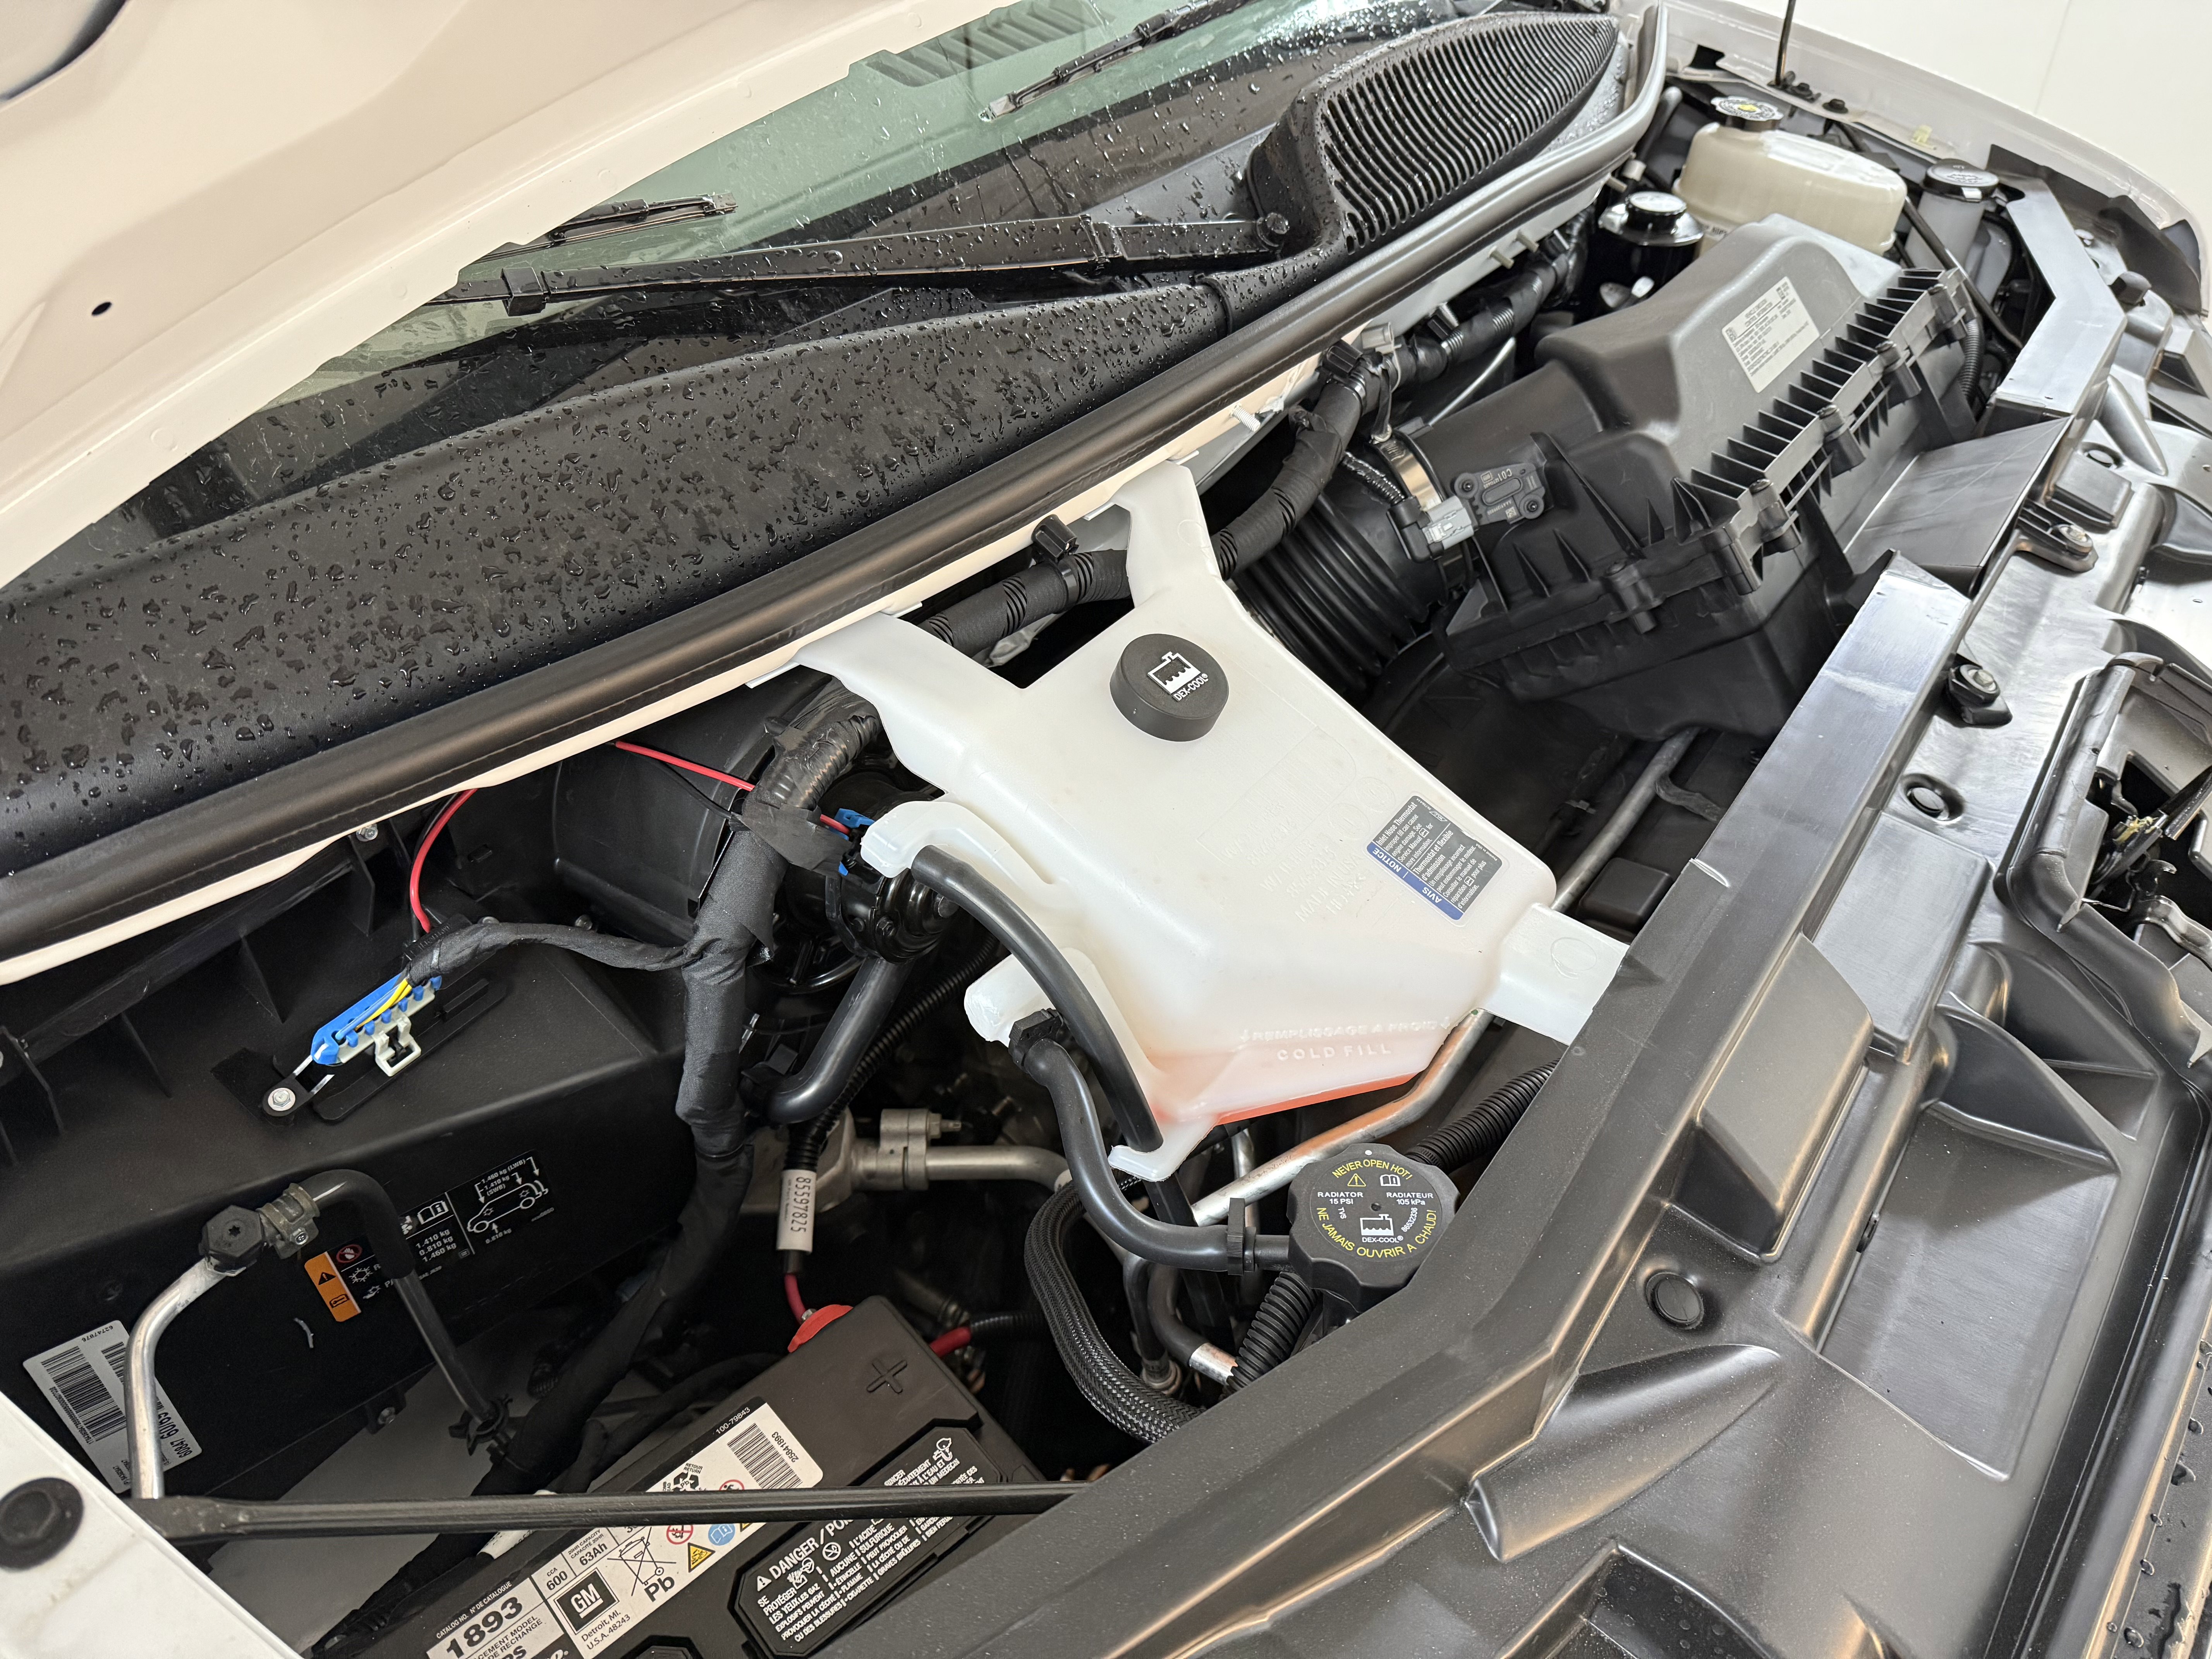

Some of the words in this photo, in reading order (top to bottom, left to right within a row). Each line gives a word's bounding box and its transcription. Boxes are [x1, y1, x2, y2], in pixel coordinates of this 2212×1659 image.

[1376, 833, 1388, 846] Inlet
[1384, 823, 1398, 836] Hose
[1393, 801, 1417, 826] Thermostat
[1384, 834, 1401, 852] Improper
[1401, 824, 1410, 832] can
[1407, 814, 1419, 825] cause
[1391, 843, 1405, 857] engine
[1400, 829, 1417, 846] damage.
[1412, 822, 1422, 832] See
[1397, 847, 1412, 862] Service
[1408, 835, 1423, 850] Manual
[1425, 822, 1434, 830] for
[1432, 844, 1441, 852] et
[1436, 829, 1454, 847] flexible
[1372, 847, 1402, 872] NOTICE
[1405, 857, 1416, 868] more
[1412, 836, 1433, 859] information.
[1412, 849, 1437, 875] Thermostat
[1449, 843, 1466, 861] incorrect
[1420, 853, 1446, 881] d'admission
[1432, 859, 1455, 882] remplissage
[1435, 882, 1446, 893] peut
[1441, 860, 1464, 884] endommager
[1462, 844, 1477, 859] moteur.
[1428, 879, 1437, 887] Un
[1442, 879, 1460, 898] Consulter
[1458, 862, 1473, 878] manuel
[1449, 883, 1469, 904] réparation
[1470, 867, 1482, 879] pour
[1476, 859, 1488, 870] plus
[1421, 886, 1442, 904] AVIS
[1456, 883, 1480, 909] d'information.
[1278, 1046, 1335, 1061] COLD
[1344, 1044, 1392, 1057] FILL
[1332, 1161, 1363, 1178] NEVER
[1363, 1159, 1389, 1169] OPEN
[1390, 1164, 1413, 1180] HOT!
[790, 1176, 811, 1233] 85597825
[1317, 1207, 1329, 1221] NE
[1338, 1207, 1346, 1219] TVS
[1401, 1207, 1417, 1232] 86532336
[1415, 1209, 1436, 1243] CHAUD!
[414, 1233, 439, 1250] 1.410
[438, 1227, 451, 1238] kg
[442, 1235, 455, 1245] kg
[445, 1241, 458, 1252] kg
[1322, 1223, 1355, 1251] JAMAIS
[1357, 1246, 1405, 1258] OUVRIR
[715, 1406, 751, 1435] 100-79843
[169, 1435, 193, 1460] 60847
[771, 1430, 799, 1463] 25841893
[683, 1465, 701, 1475] RETURN
[685, 1461, 702, 1471] RETOUR
[921, 1464, 939, 1480] L'EAU
[936, 1459, 946, 1469] ET
[966, 1465, 978, 1477] DES
[679, 1479, 690, 1489] Pb
[928, 1475, 939, 1485] UN
[579, 1528, 601, 1547] CAPACITY
[852, 1523, 878, 1546] L'ACIDE
[858, 1522, 895, 1554] SULFURIQUE
[865, 1547, 881, 1561] PEUT
[878, 1525, 908, 1551] PROVOQUER
[924, 1525, 938, 1537] BIEN
[570, 1541, 593, 1559] CAPACITÉ
[578, 1540, 608, 1567] 63Ah
[768, 1535, 820, 1580] DANGER
[871, 1559, 881, 1569] LA
[877, 1546, 896, 1563] CÉCITÉ
[893, 1540, 904, 1551] OU
[901, 1535, 911, 1544] DE
[546, 1566, 558, 1577] CCA
[828, 1551, 858, 1577] AUCUNE
[834, 1561, 862, 1585] ÉTINCELLE
[876, 1557, 899, 1576] GRAVES
[544, 1570, 569, 1592] 600
[643, 1571, 677, 1602] Pb
[797, 1591, 809, 1603] LES
[807, 1582, 821, 1595] GAZ
[840, 1572, 864, 1593] FLAMME
[846, 1576, 875, 1601] CIGARETTE
[435, 1618, 460, 1639] CATALOG
[458, 1612, 469, 1623] NO.
[475, 1601, 484, 1610] DE
[483, 1580, 513, 1605] CATALOGUE
[568, 1583, 601, 1614] GM
[757, 1595, 770, 1608] SE
[761, 1585, 798, 1616] PROTÉGER
[768, 1609, 784, 1625] LES
[780, 1596, 801, 1614] YEUX
[775, 1607, 804, 1632] EXPLOSIFS
[800, 1590, 826, 1612] PEUVENT
[441, 1593, 526, 1659] 1893
[510, 1614, 538, 1637] MODEL
[580, 1617, 611, 1642] Detroit,
[607, 1608, 621, 1621] MI.
[780, 1613, 814, 1640] PROVOQUER
[810, 1607, 820, 1617] LA
[817, 1593, 837, 1611] CÉCITÉ
[802, 1623, 815, 1635] DES
[812, 1601, 843, 1627] BLESSURES
[499, 1618, 543, 1653] RECHANGE
[586, 1631, 609, 1650] U.S.A.
[606, 1613, 632, 1634] 48243
